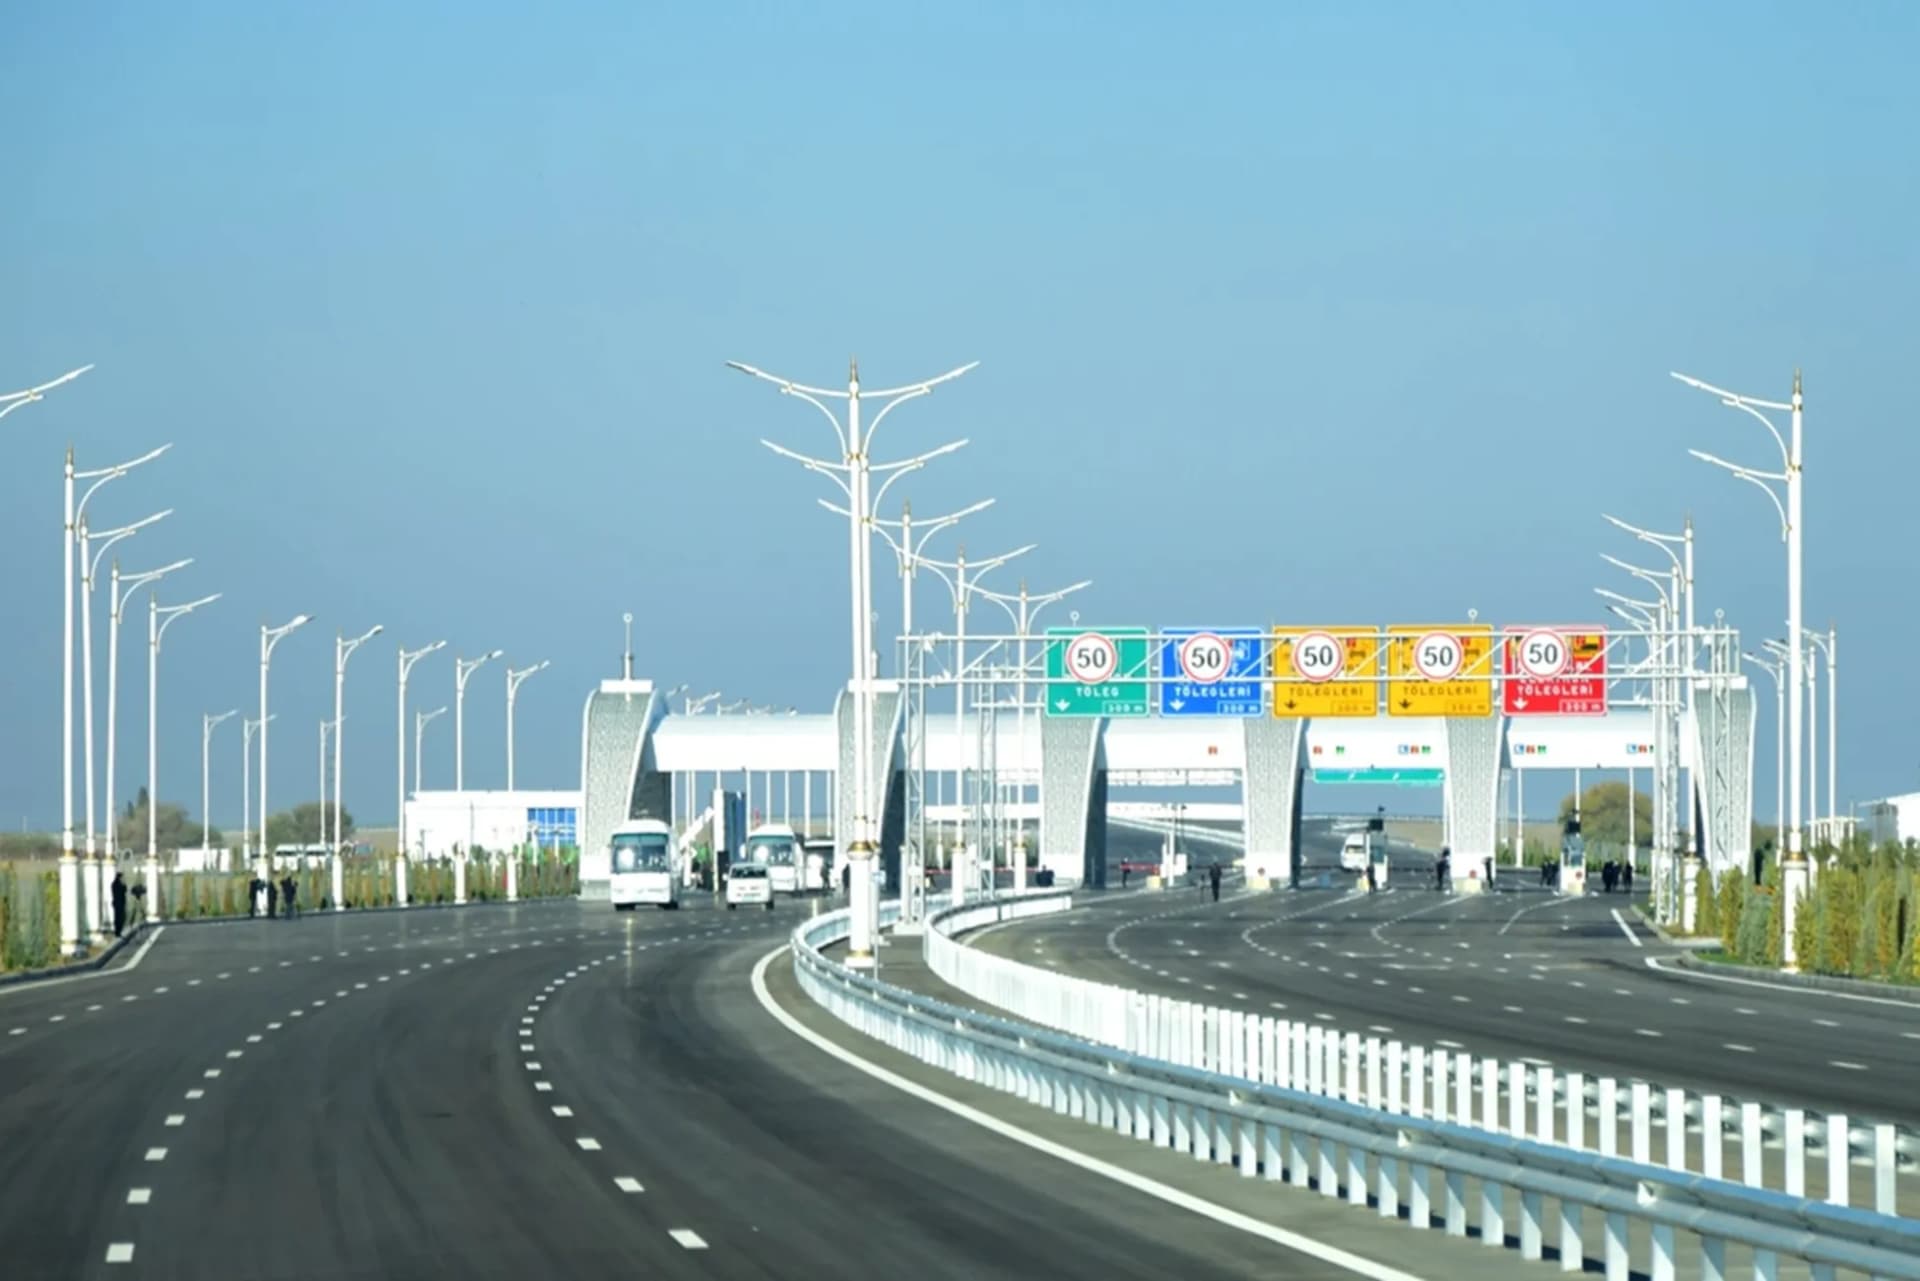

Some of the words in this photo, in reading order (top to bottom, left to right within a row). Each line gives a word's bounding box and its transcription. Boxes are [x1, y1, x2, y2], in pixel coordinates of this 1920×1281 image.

[1078, 647, 1107, 669] 50
[1191, 646, 1221, 669] 50
[1304, 645, 1333, 667] 50
[1424, 645, 1453, 667] 50
[1529, 643, 1558, 665] 50
